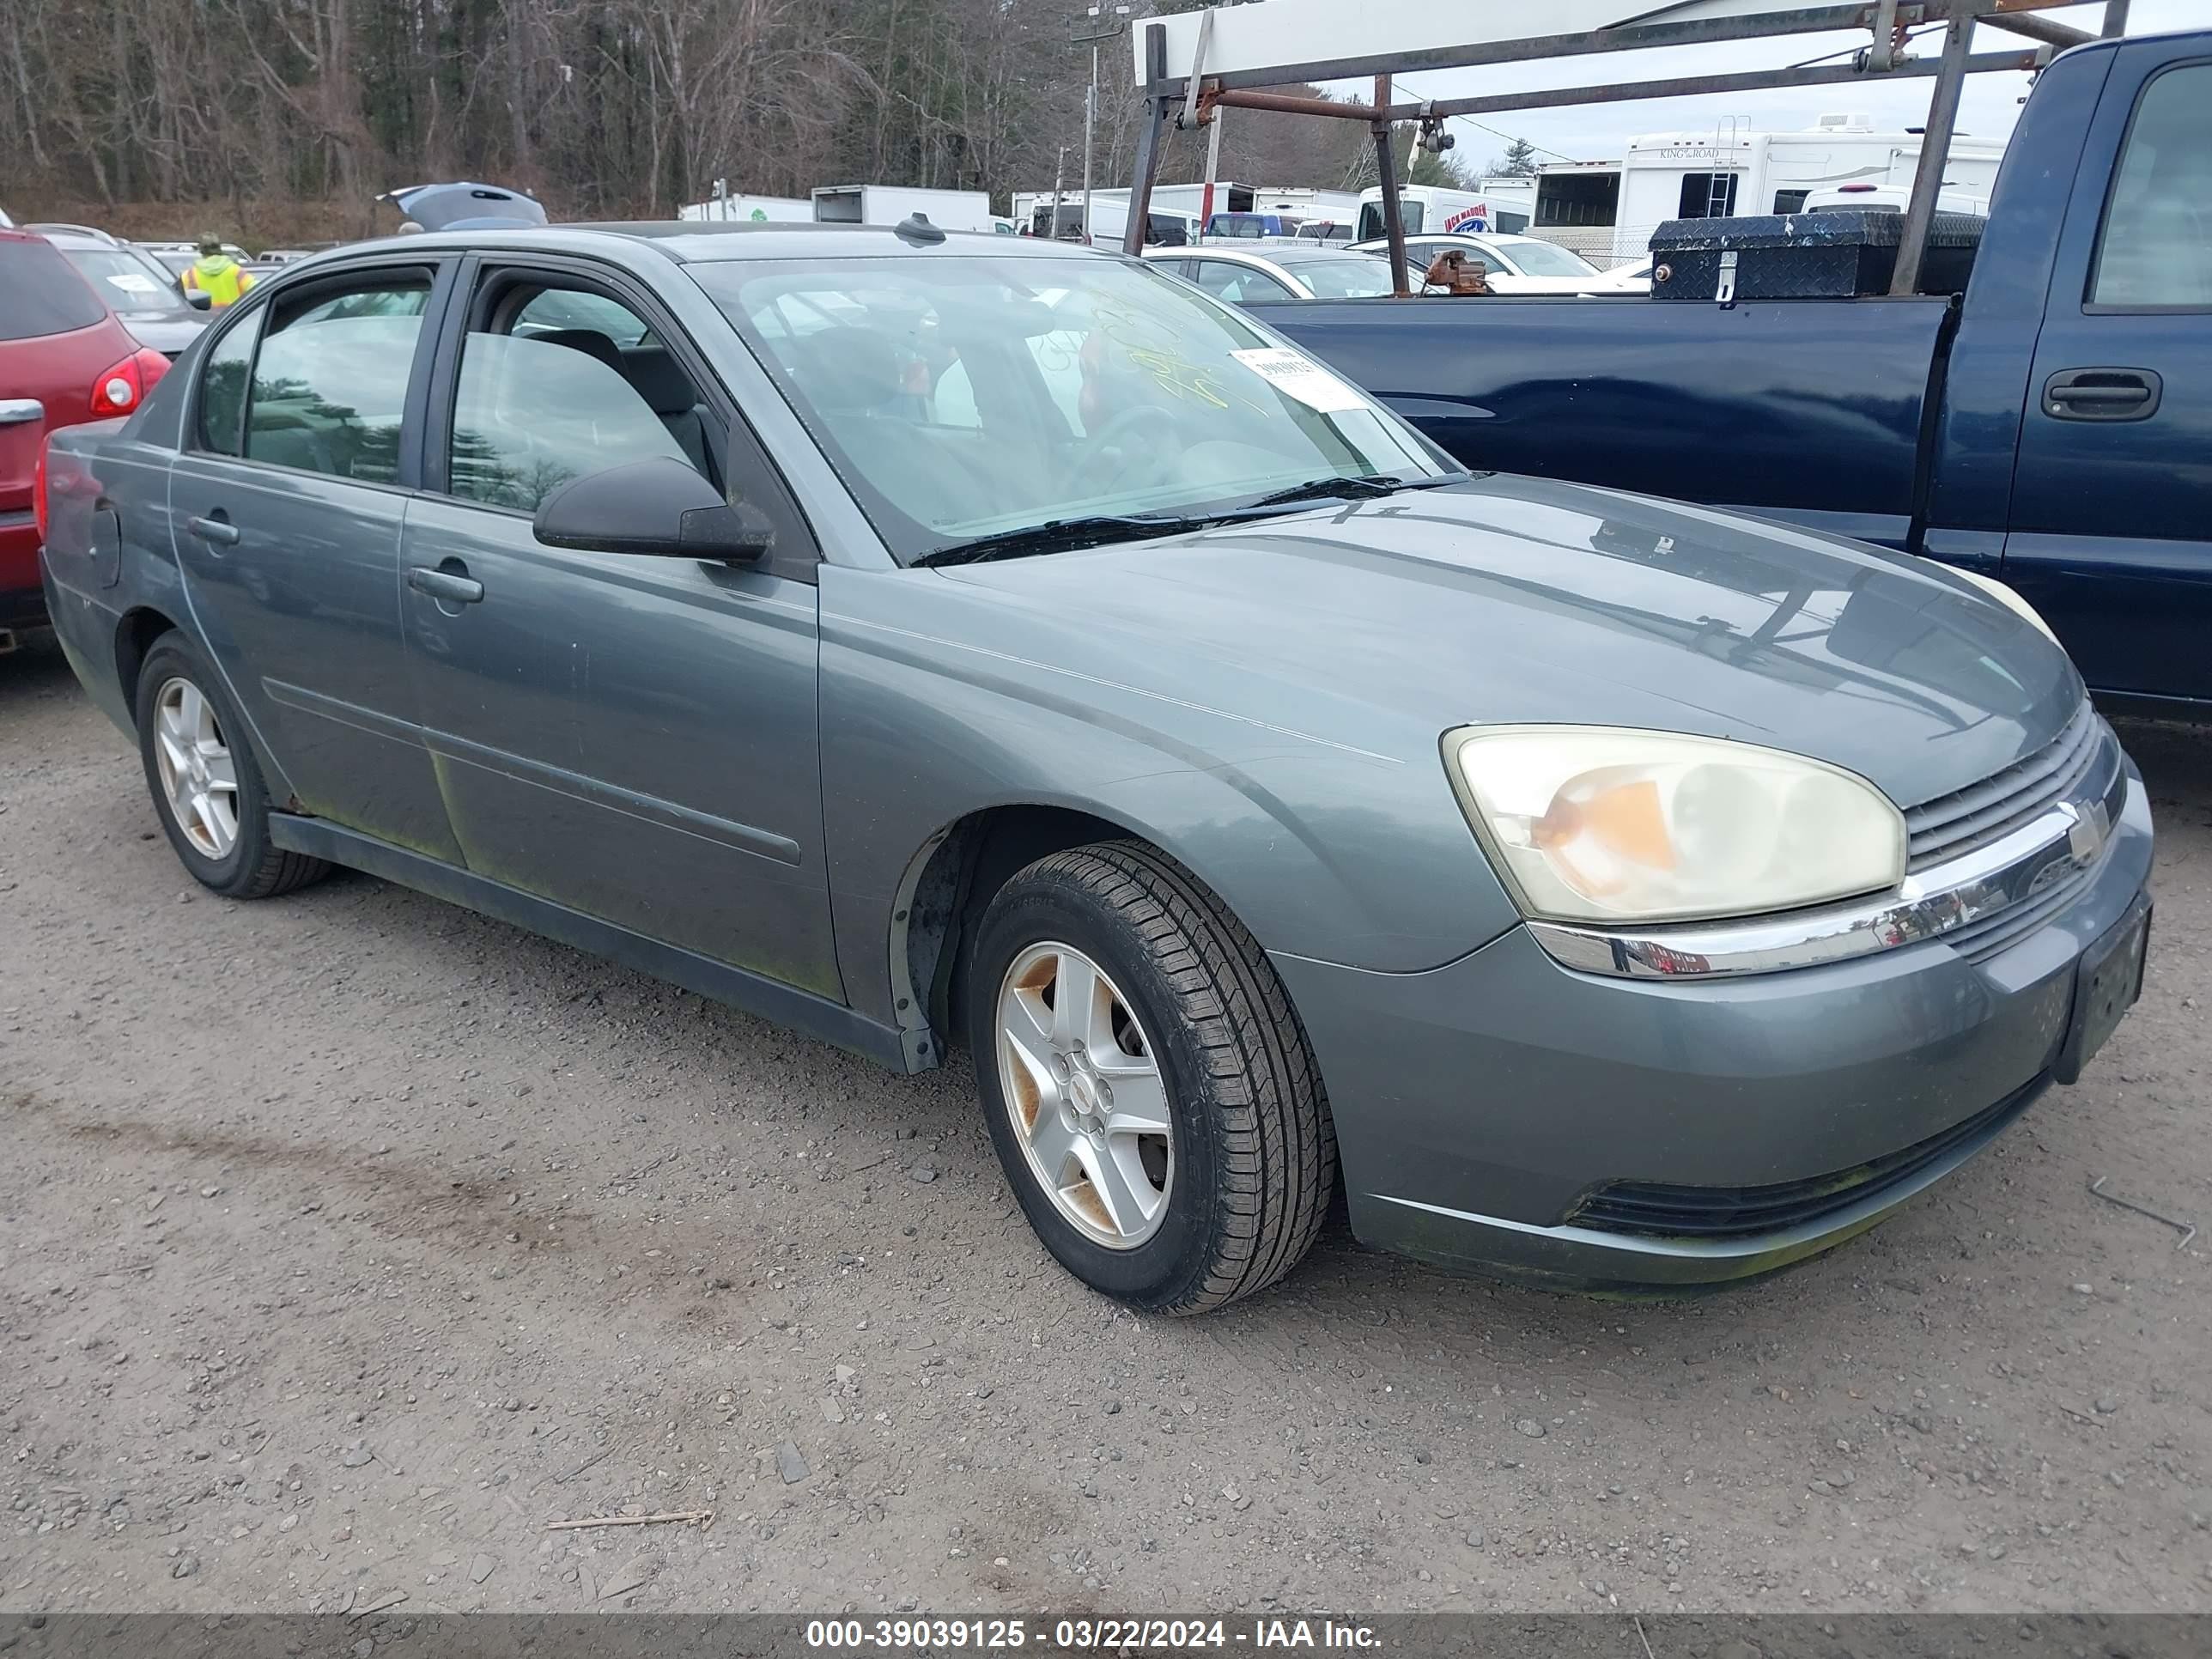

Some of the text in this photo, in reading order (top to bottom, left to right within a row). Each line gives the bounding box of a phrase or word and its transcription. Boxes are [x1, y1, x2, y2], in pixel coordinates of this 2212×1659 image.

[1660, 149, 1683, 158] KING
[1693, 149, 1719, 158] ROAD
[1444, 203, 1487, 233] JACK MADDEN
